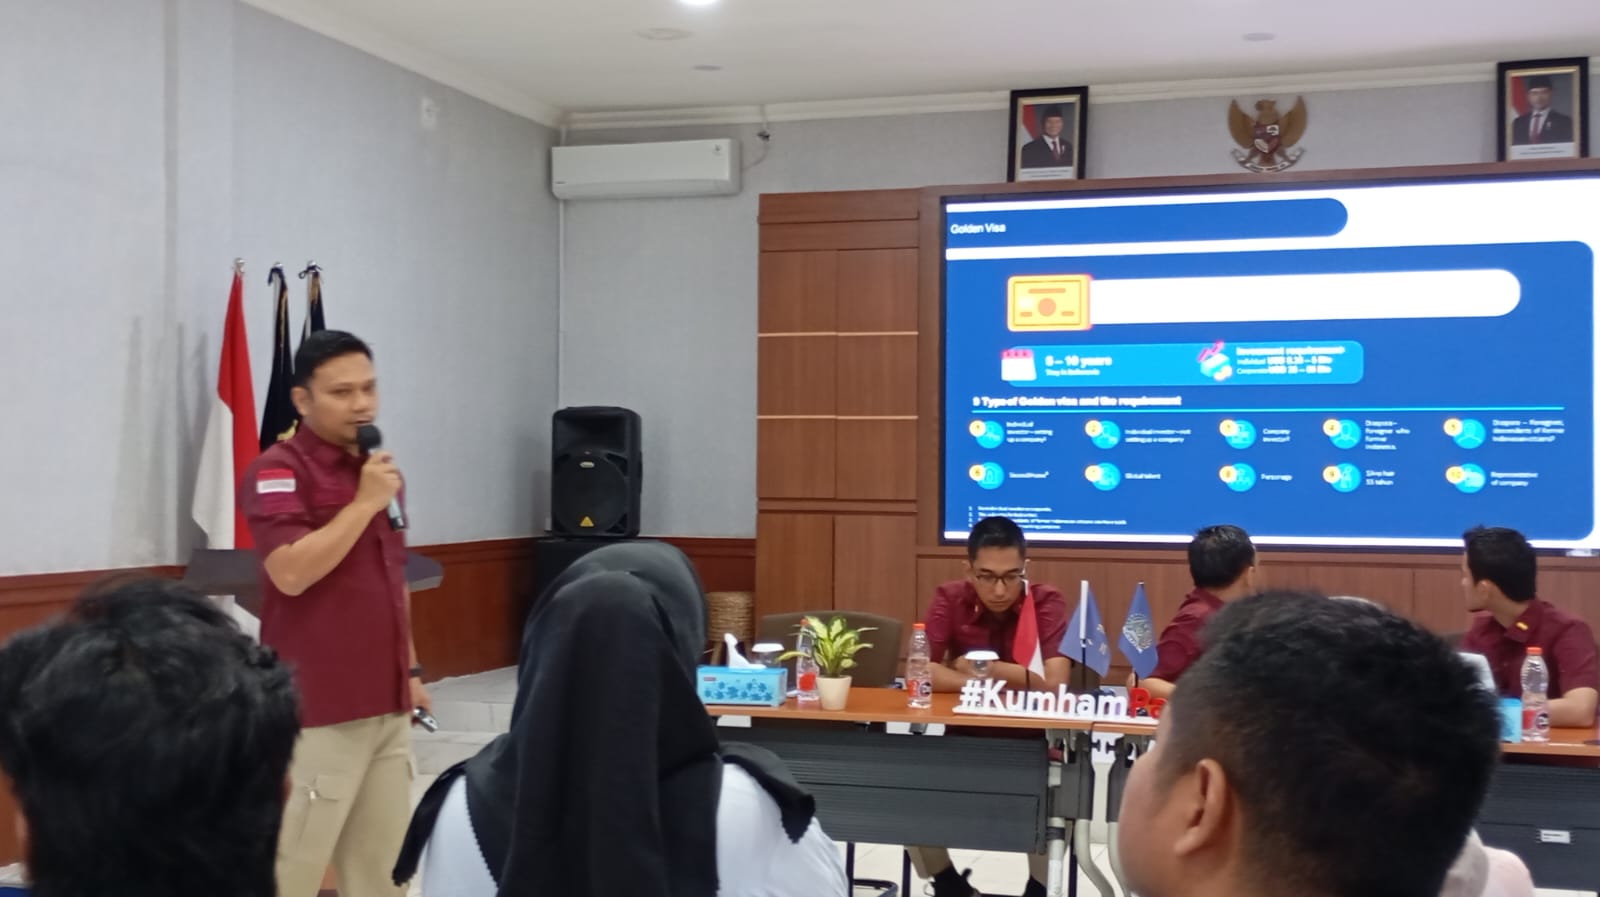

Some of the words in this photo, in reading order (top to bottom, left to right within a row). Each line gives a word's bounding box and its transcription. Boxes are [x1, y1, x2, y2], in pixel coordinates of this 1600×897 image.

[950, 223, 984, 235] Golden
[984, 222, 1007, 233] Visa
[1080, 356, 1114, 369] years
[981, 396, 1006, 409] Type
[1006, 396, 1018, 407] of
[1018, 396, 1056, 407] Golden
[1056, 396, 1078, 407] visa
[1079, 396, 1099, 407] and
[1099, 396, 1117, 407] the
[1118, 395, 1183, 408] requirement
